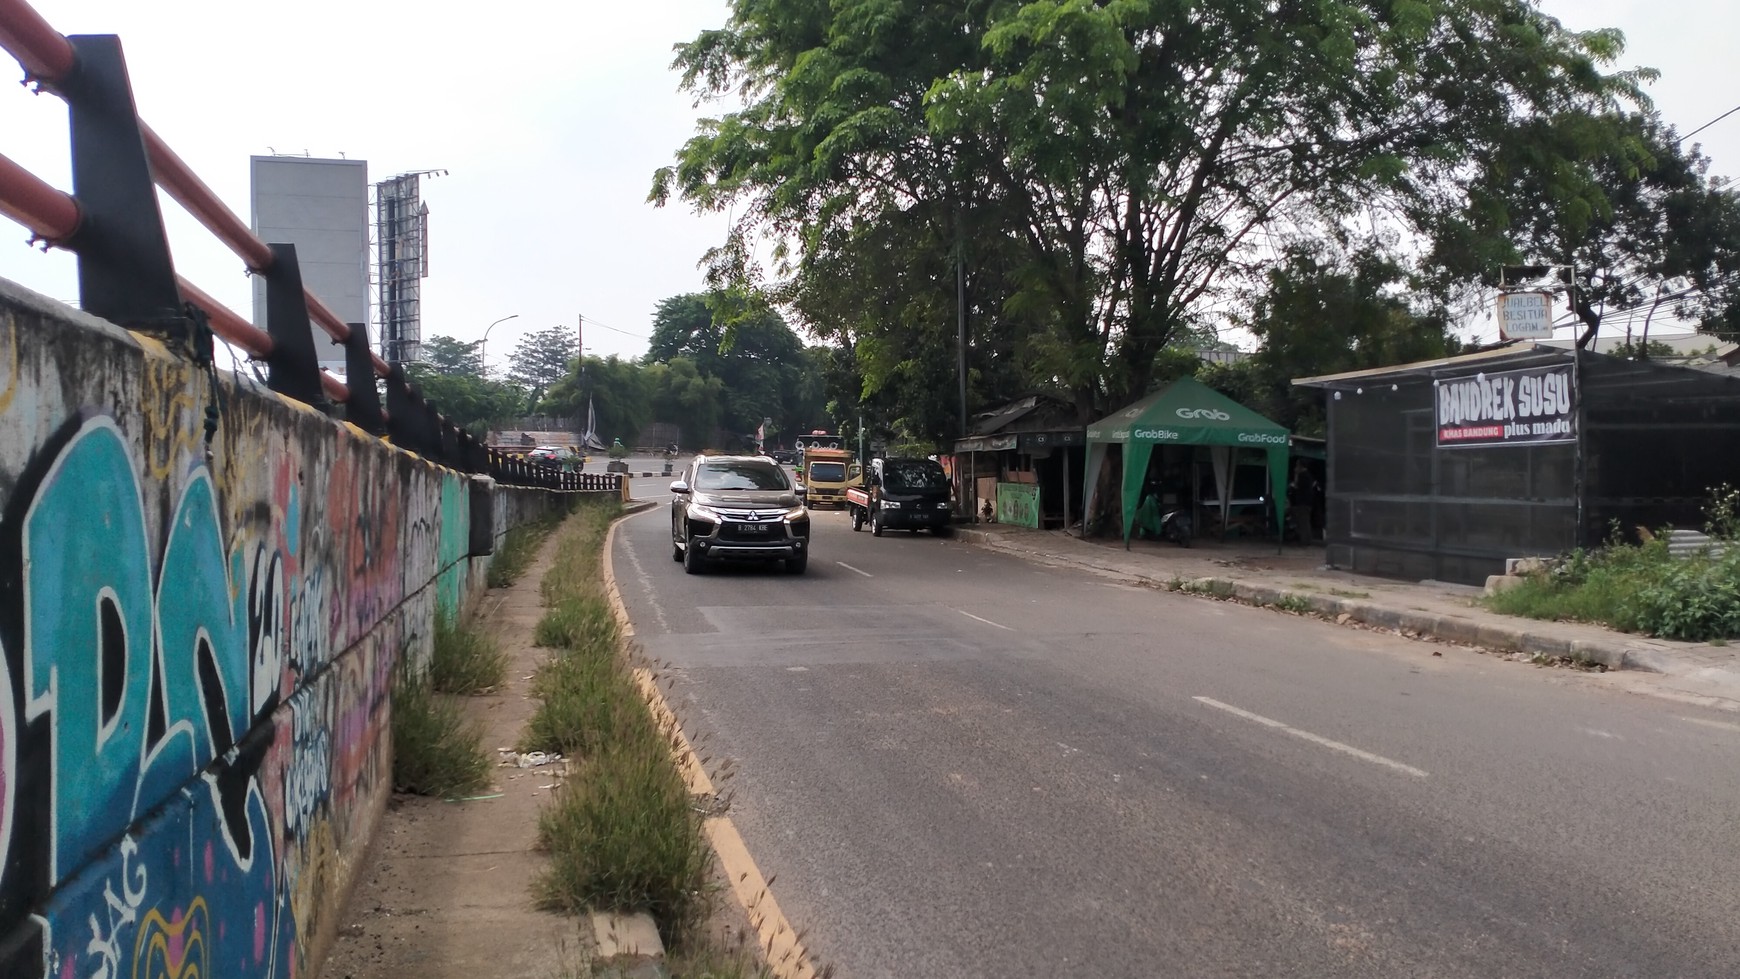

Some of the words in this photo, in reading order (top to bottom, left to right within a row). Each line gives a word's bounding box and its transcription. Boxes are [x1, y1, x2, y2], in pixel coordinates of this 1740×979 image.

[1439, 377, 1515, 424] BANDREK
[1519, 373, 1570, 416] SUSU
[1175, 407, 1230, 421] Grab
[1134, 429, 1178, 440] GrabBike
[1444, 429, 1462, 438] KHAS
[1463, 426, 1499, 438] BANDUNG
[1504, 422, 1530, 439] plus
[1532, 418, 1570, 436] madu
[1238, 432, 1286, 444] GrabFood
